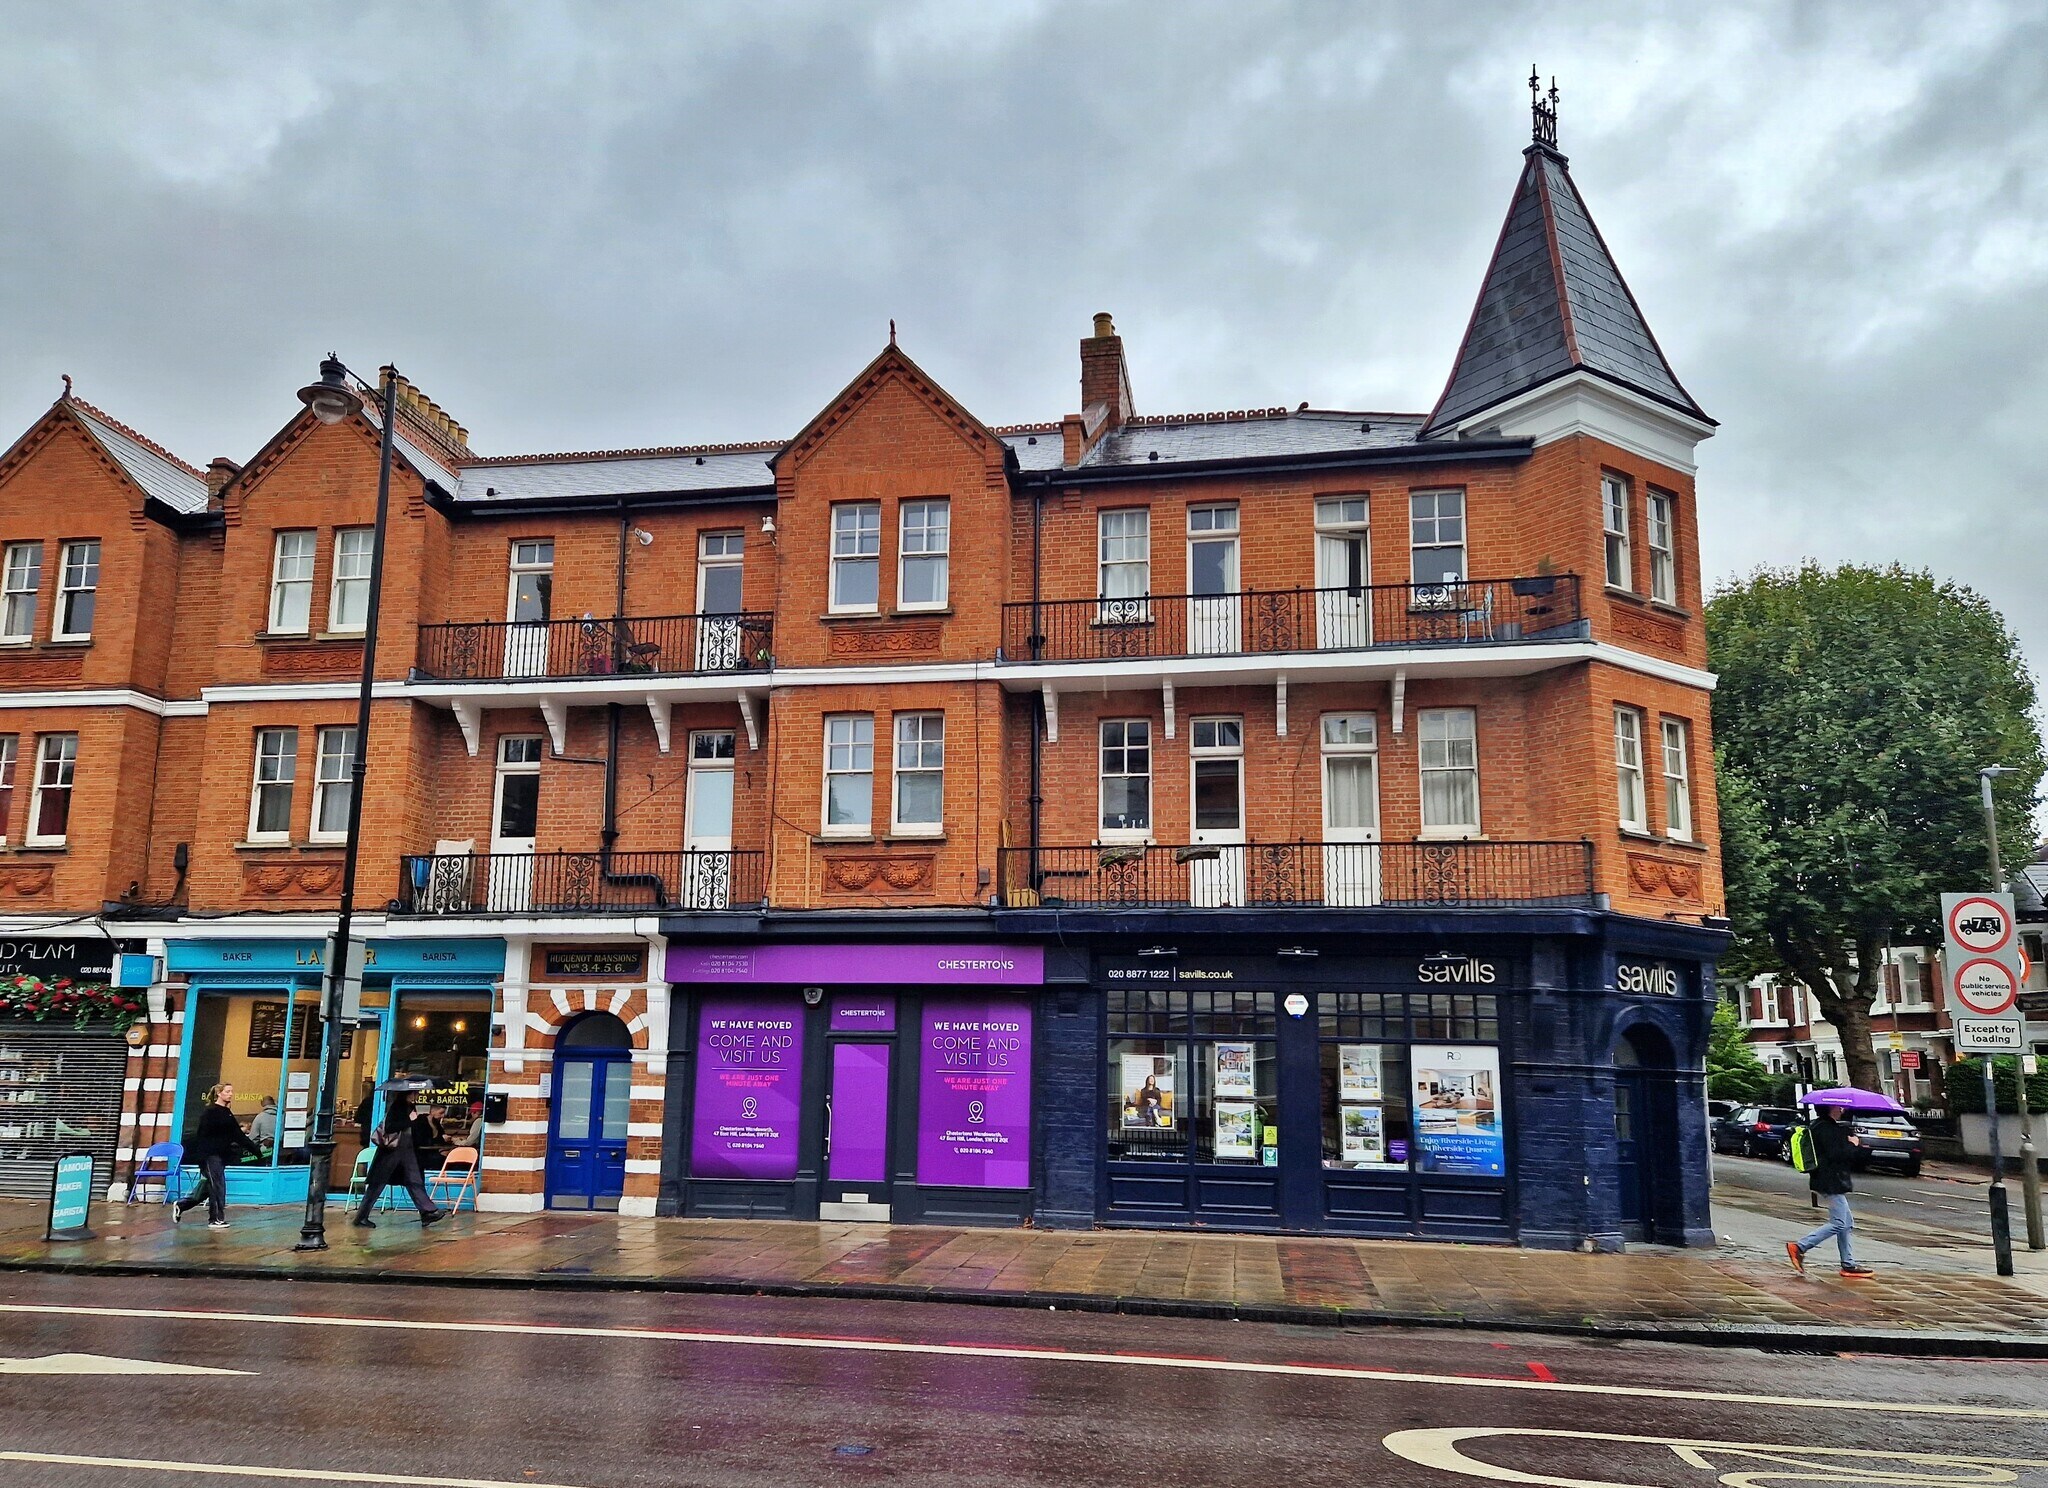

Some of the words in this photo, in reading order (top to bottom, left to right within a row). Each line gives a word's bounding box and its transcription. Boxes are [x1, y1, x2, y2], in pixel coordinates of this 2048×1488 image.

[20, 943, 75, 959] GLAM
[422, 952, 457, 961] BARISTA
[222, 952, 253, 962] BAKER
[594, 954, 638, 962] MANSIONS
[937, 960, 1015, 970] CHESTERTONS
[1417, 958, 1496, 983] savills
[1107, 969, 1124, 979] 020
[1126, 969, 1147, 979] 8877
[1149, 970, 1170, 979] 1222
[1179, 970, 1234, 979] savills.co.uk
[1978, 975, 1990, 983] No
[1617, 964, 1678, 996] savills
[840, 1009, 886, 1017] CHESTERTONS
[711, 1020, 726, 1029] WE
[729, 1020, 754, 1029] HAVE
[757, 1021, 792, 1029] MOVED
[934, 1022, 949, 1030] WE
[953, 1022, 979, 1031] HAVE
[982, 1023, 1019, 1032] MOVED
[1964, 1024, 1999, 1035] Except
[2001, 1025, 2016, 1034] for
[709, 1034, 755, 1047] COME
[760, 1035, 793, 1048] AND
[932, 1036, 981, 1050] COME
[986, 1038, 1020, 1051] AND
[1971, 1034, 2011, 1045] loading
[720, 1050, 756, 1063] VISIT
[761, 1051, 781, 1063] US
[944, 1052, 982, 1065] VISIT
[987, 1053, 1008, 1066] US
[234, 1092, 264, 1101] BARISTA
[437, 1095, 468, 1104] BARISTA
[1419, 1136, 1440, 1145] Enjoy
[1441, 1137, 1473, 1145] Riverside
[1474, 1138, 1497, 1147] Living
[1432, 1144, 1464, 1153] Riverside
[1465, 1146, 1493, 1154] Quarter
[57, 1161, 92, 1173] LAMOUR
[56, 1181, 83, 1192] BAKER
[53, 1206, 84, 1218] BARISTA
